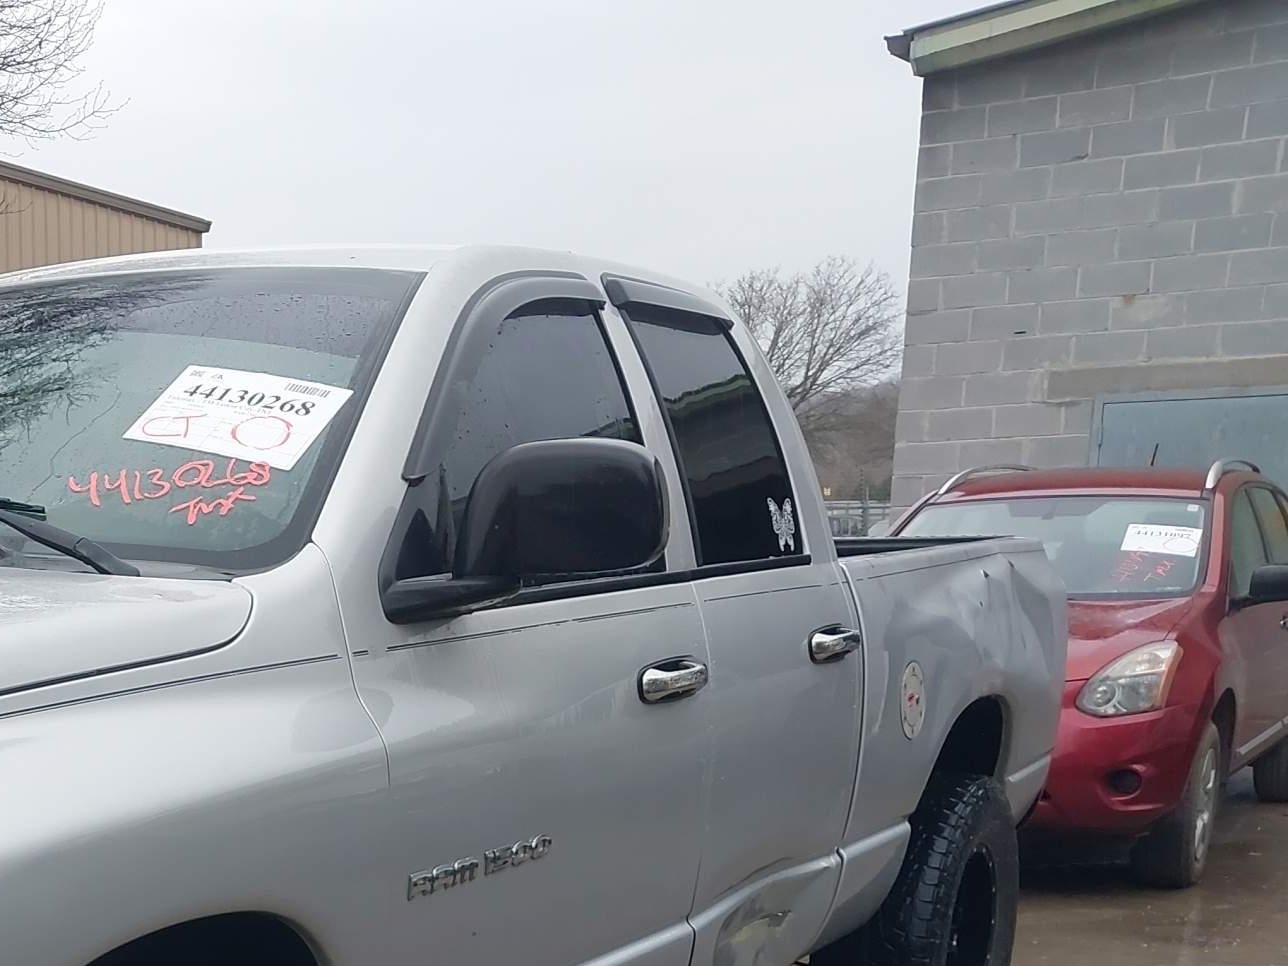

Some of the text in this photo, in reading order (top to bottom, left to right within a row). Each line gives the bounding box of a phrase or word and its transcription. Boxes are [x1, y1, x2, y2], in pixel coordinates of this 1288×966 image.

[183, 383, 316, 416] 44130268
[68, 458, 270, 507] 44130268
[407, 856, 479, 901] RAM
